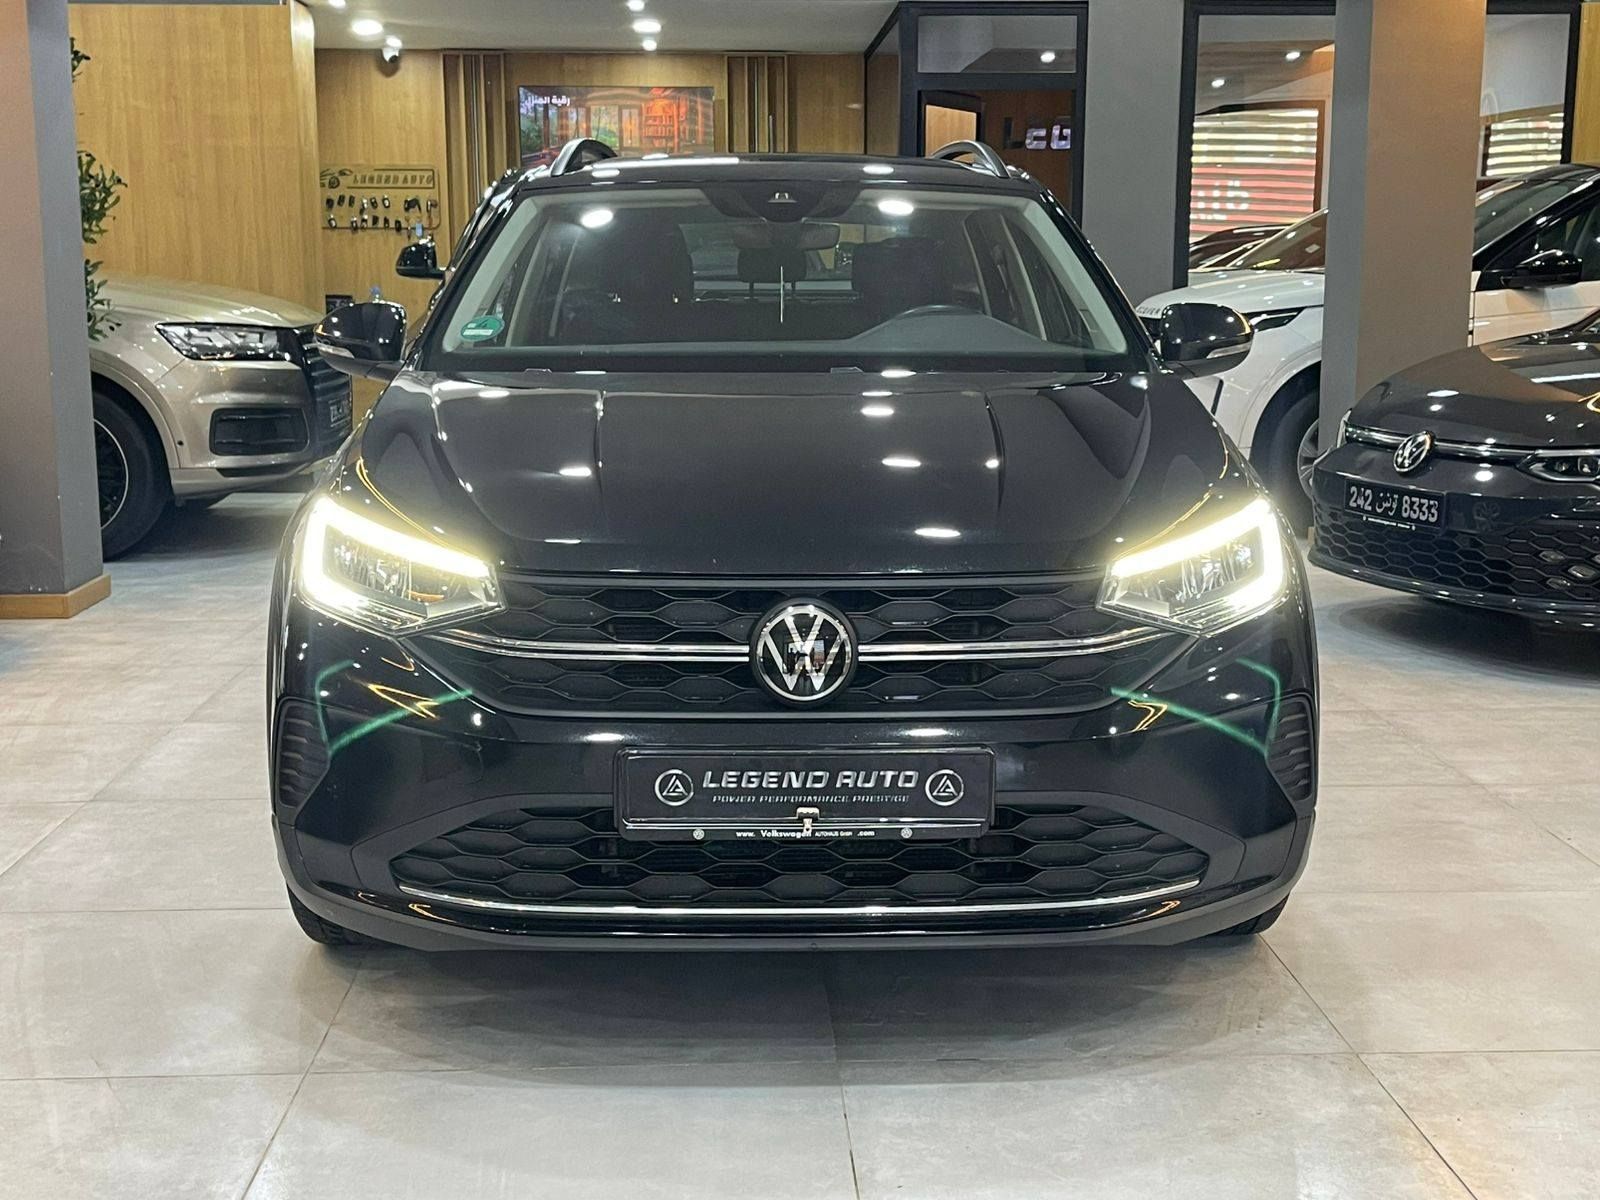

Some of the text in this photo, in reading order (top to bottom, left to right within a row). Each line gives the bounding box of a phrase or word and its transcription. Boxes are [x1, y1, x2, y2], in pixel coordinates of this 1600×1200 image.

[1349, 486, 1439, 522] 242 تونس 8333
[702, 771, 919, 788] LEGEND AUTO
